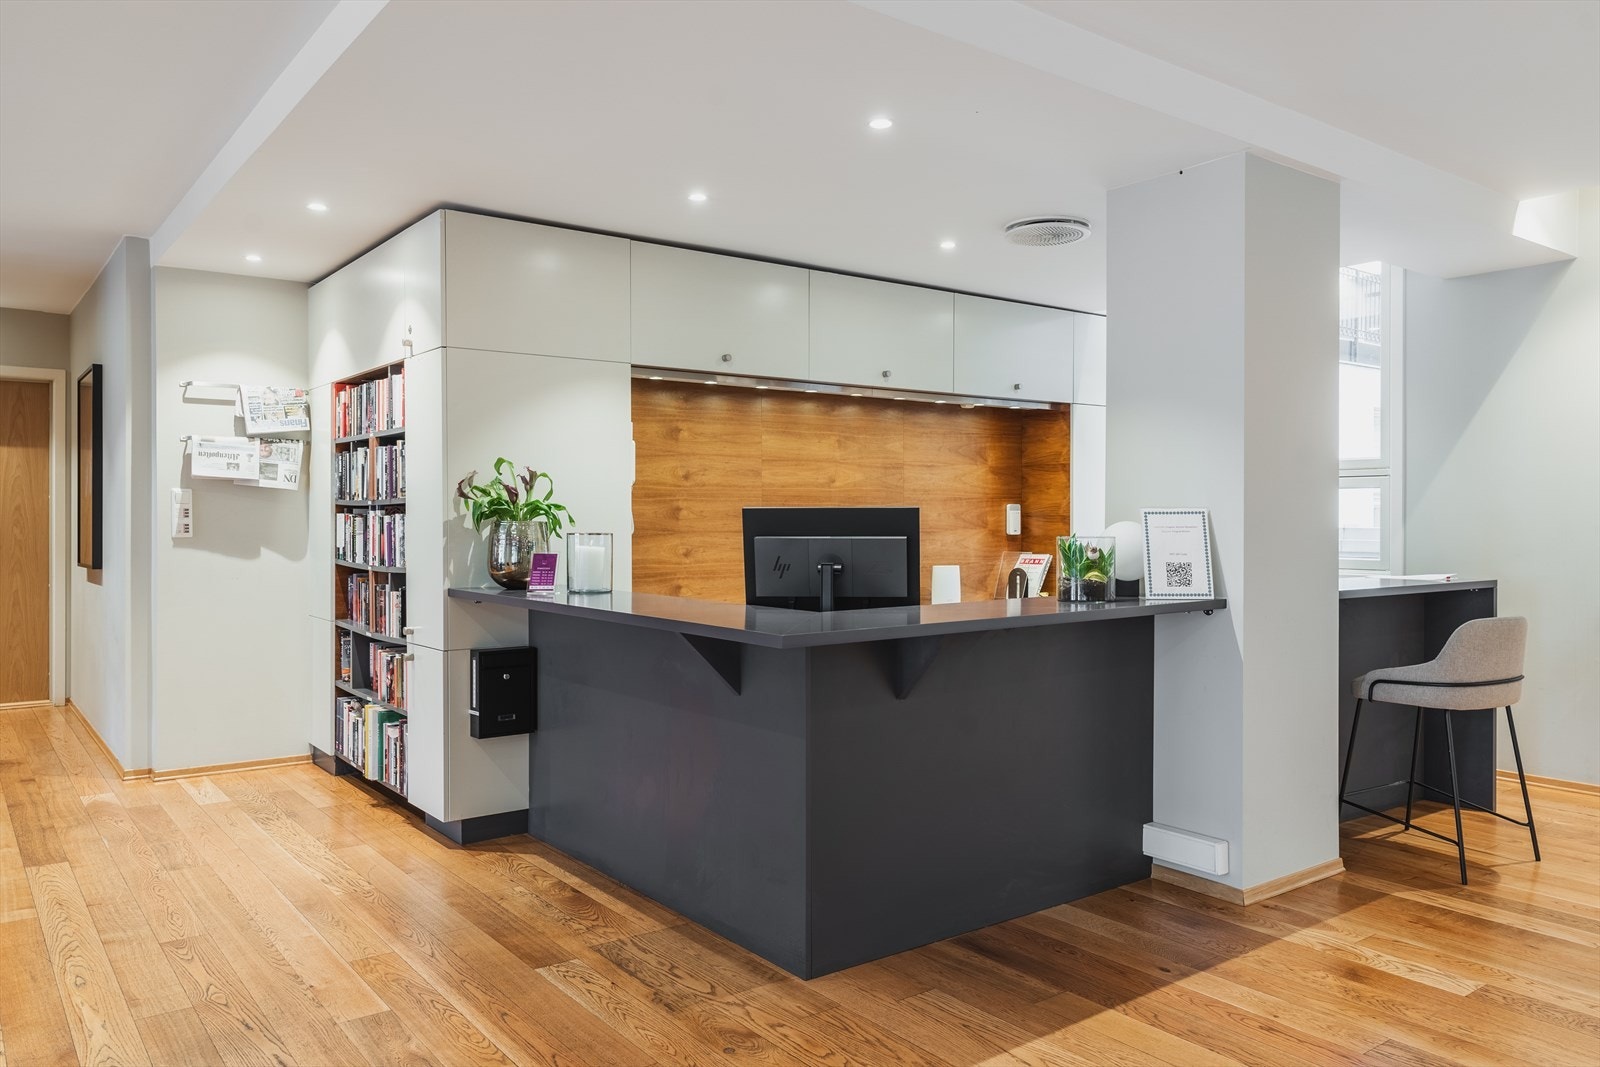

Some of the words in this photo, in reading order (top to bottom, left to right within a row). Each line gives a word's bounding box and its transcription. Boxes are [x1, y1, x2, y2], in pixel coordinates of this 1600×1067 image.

[198, 451, 240, 462] Aftenposten
[283, 474, 297, 484] DN
[772, 555, 791, 579] hp
